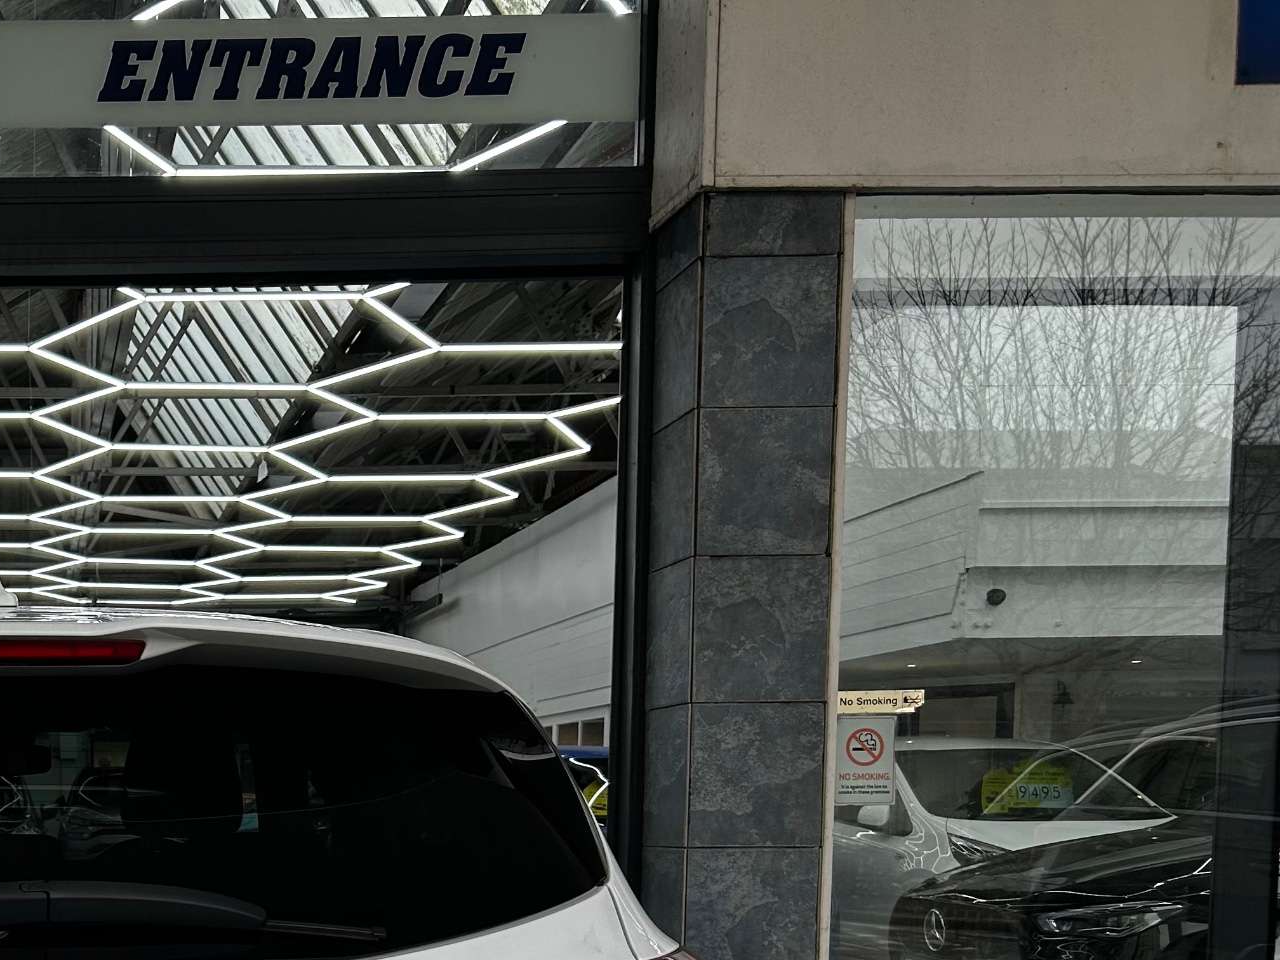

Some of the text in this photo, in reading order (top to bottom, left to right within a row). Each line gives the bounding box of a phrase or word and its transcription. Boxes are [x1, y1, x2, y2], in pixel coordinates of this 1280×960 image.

[97, 33, 526, 101] ENTRANCE
[839, 697, 898, 706] No Smoking
[839, 772, 851, 781] NO
